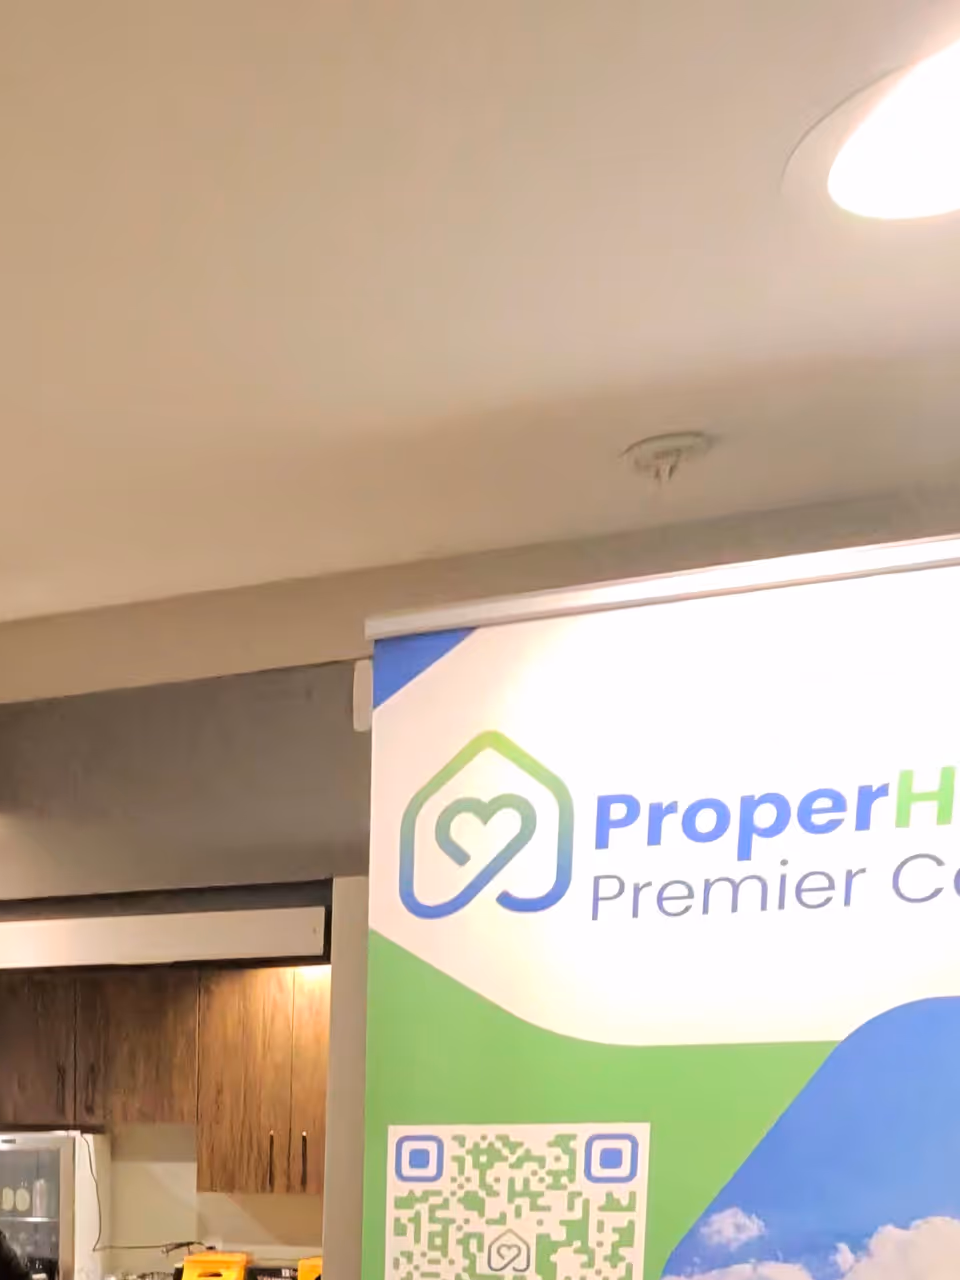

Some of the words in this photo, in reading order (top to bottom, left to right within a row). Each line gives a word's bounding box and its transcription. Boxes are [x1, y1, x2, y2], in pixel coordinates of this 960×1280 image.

[595, 766, 956, 861] ProperH
[591, 859, 867, 921] Premier
[892, 853, 960, 903] C
